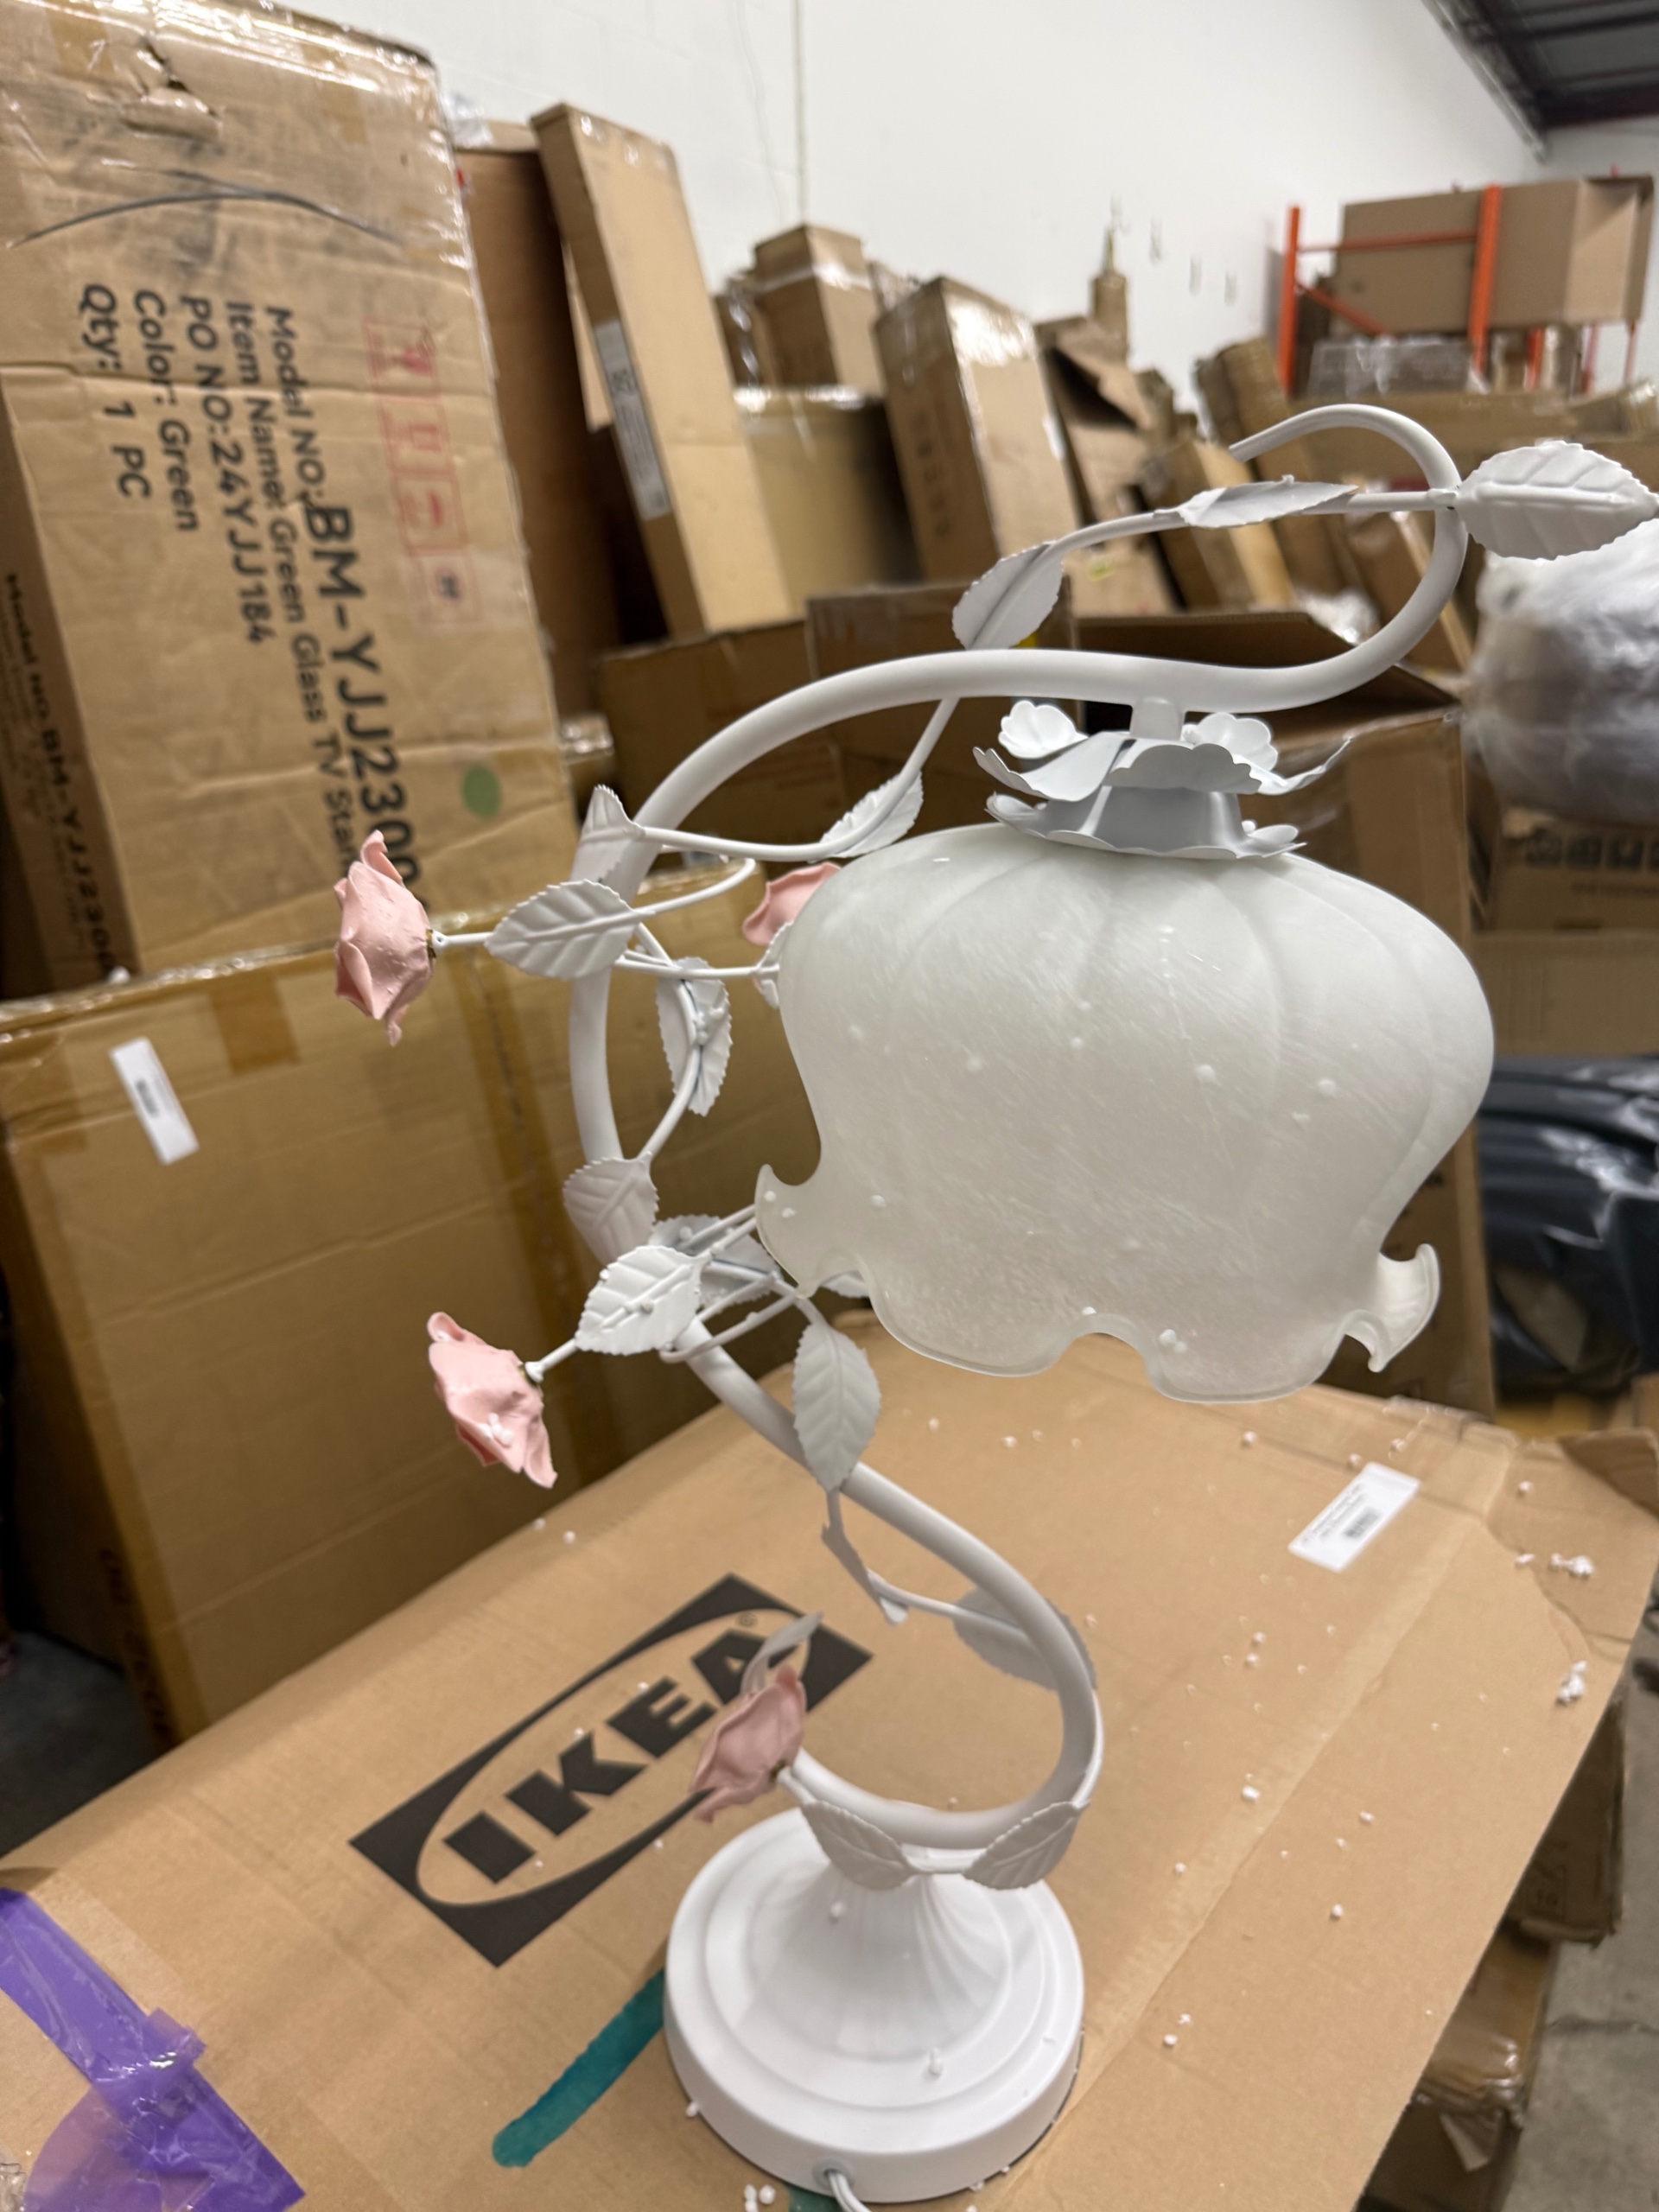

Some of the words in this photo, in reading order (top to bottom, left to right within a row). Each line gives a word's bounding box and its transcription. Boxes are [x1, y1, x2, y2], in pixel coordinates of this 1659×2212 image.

[79, 284, 123, 371] Qty:
[179, 295, 219, 352] PO
[226, 300, 261, 385] Item
[265, 306, 313, 419] Model
[103, 402, 137, 418] 1
[133, 288, 178, 405] Color:
[158, 420, 200, 531] Green
[245, 396, 287, 509] Name:
[111, 445, 153, 499] PC
[268, 518, 305, 623] Green
[291, 633, 327, 722] Glass
[312, 730, 348, 777] TV
[322, 787, 359, 880] Stan
[442, 1627, 800, 1885] IKEA
